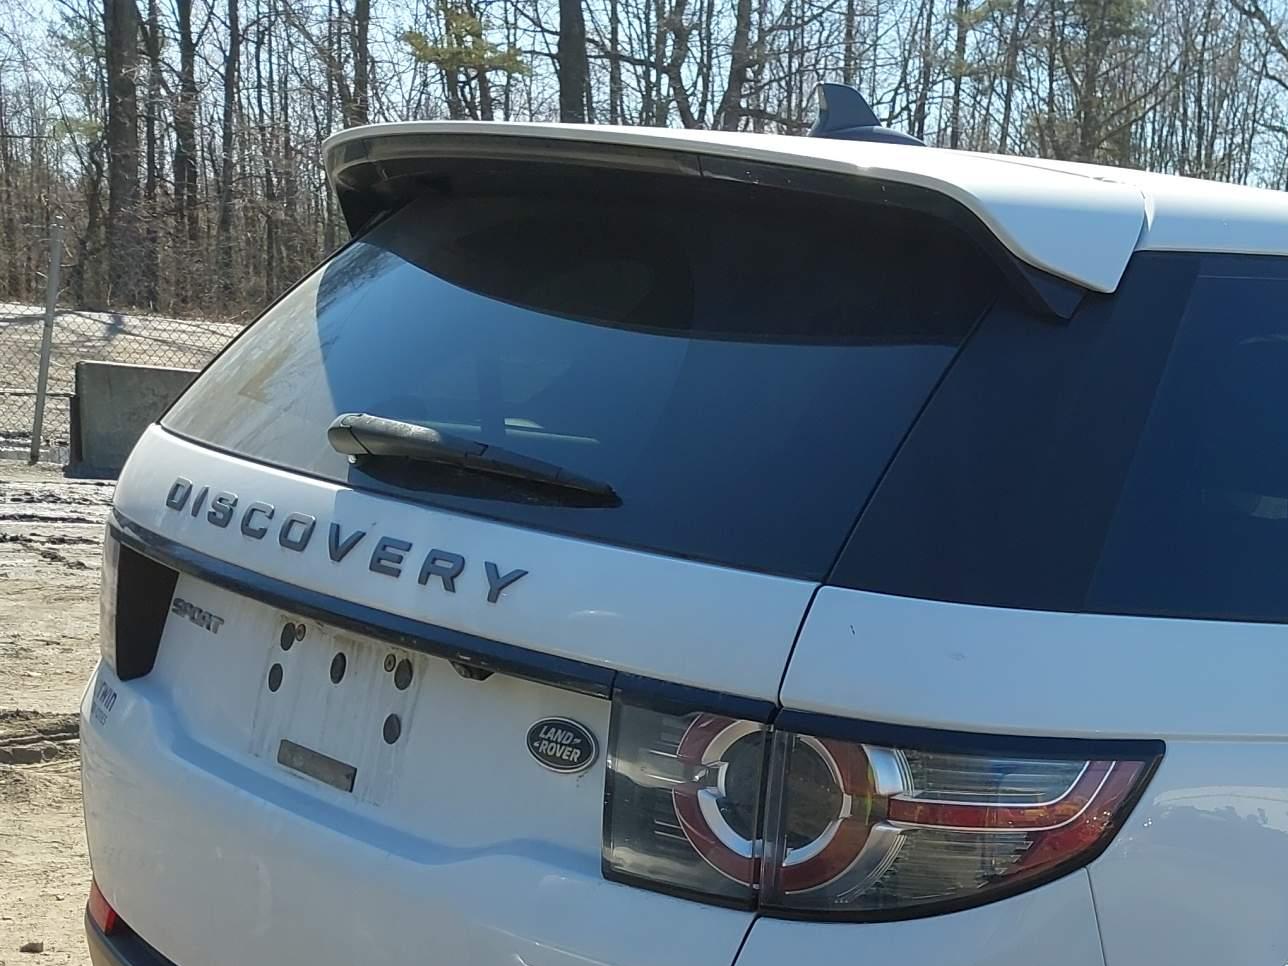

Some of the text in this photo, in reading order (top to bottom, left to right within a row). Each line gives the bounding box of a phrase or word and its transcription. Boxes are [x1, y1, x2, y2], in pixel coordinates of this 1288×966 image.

[166, 476, 528, 603] DISCOVERY
[171, 597, 225, 634] SPORT
[539, 725, 574, 744] LAND
[538, 740, 581, 762] ROVER
